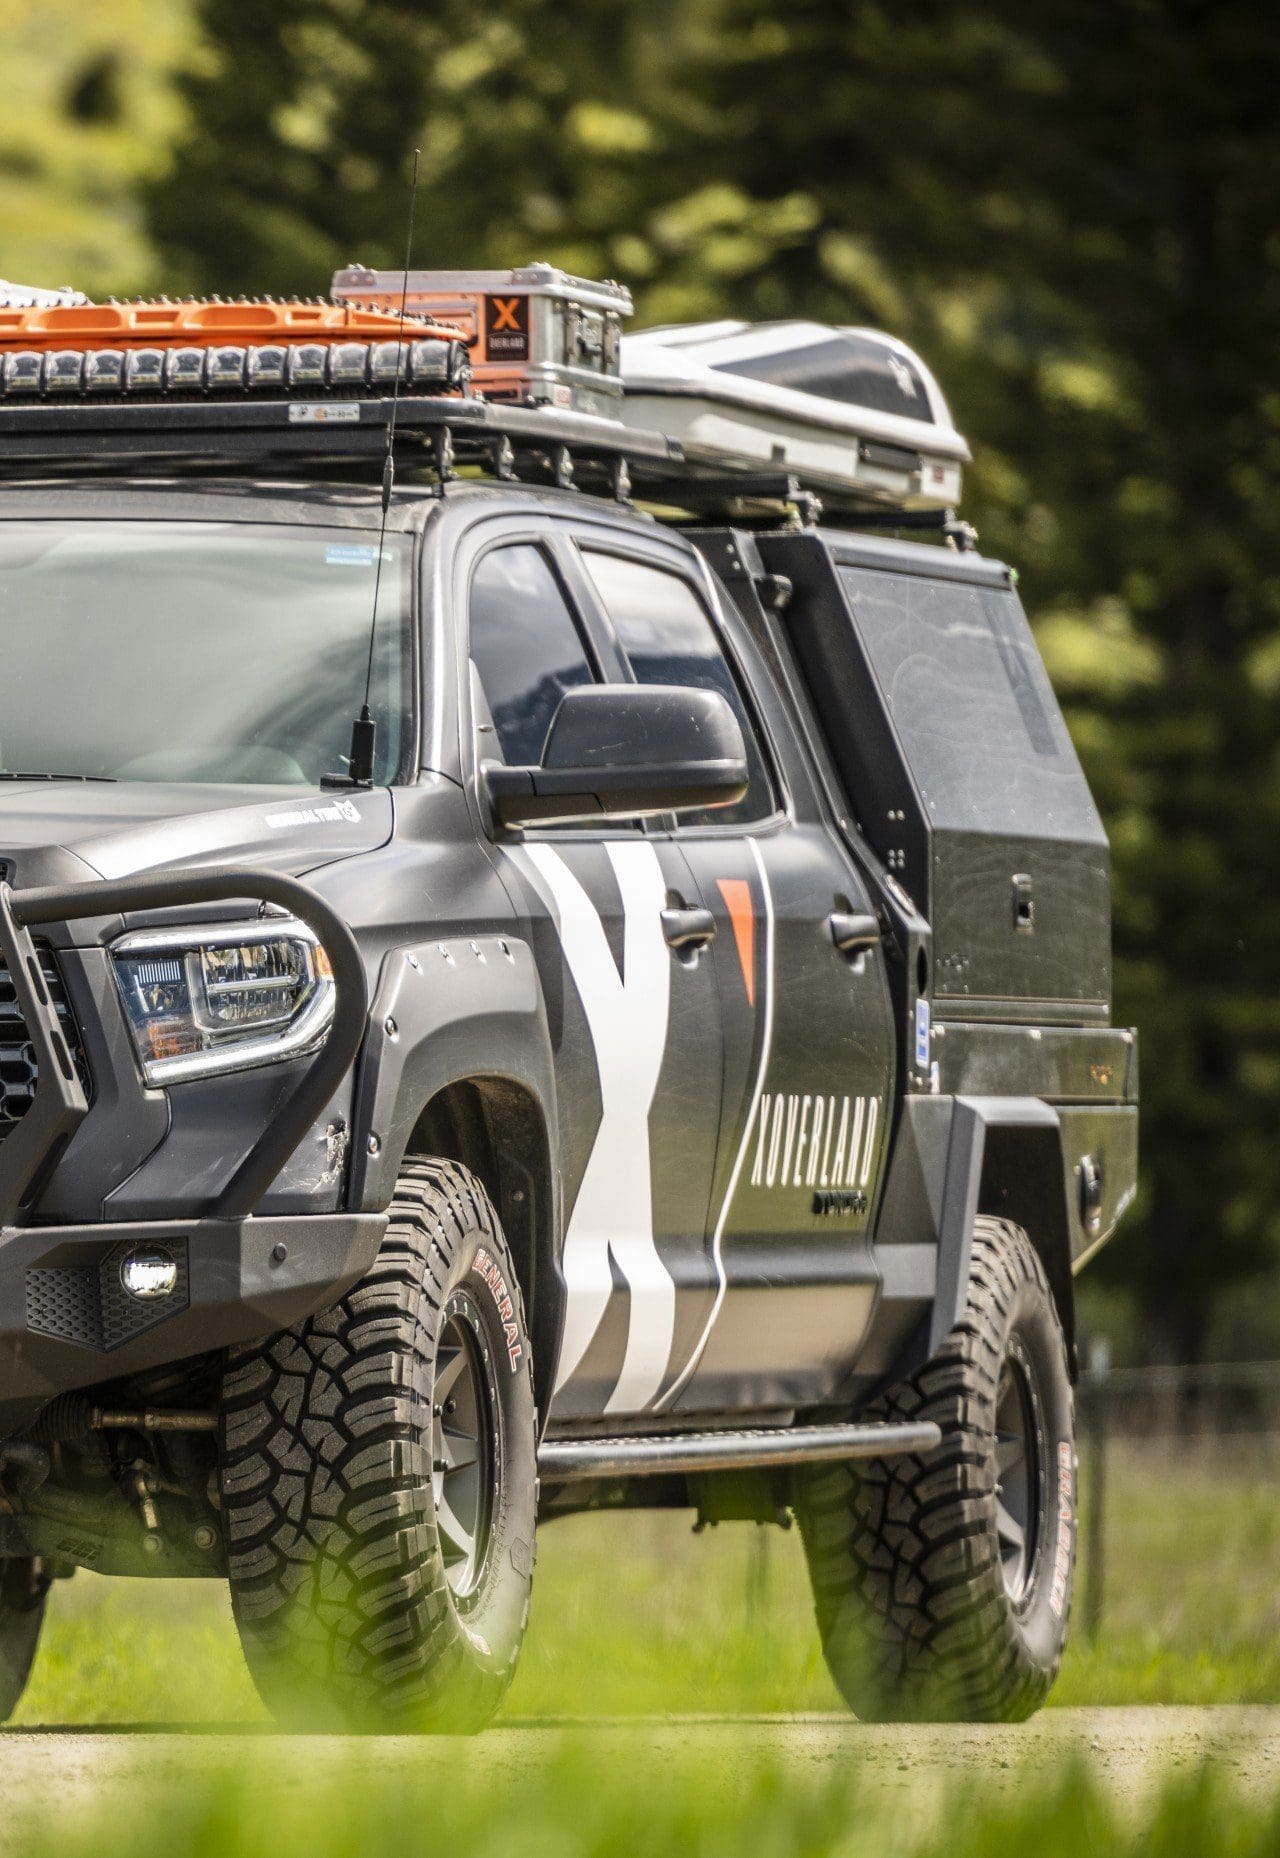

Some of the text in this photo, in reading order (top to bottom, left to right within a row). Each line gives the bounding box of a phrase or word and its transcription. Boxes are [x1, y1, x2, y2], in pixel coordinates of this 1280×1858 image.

[492, 298, 521, 330] X
[750, 1092, 878, 1188] XOVERLAND
[471, 1248, 522, 1373] GENERAL
